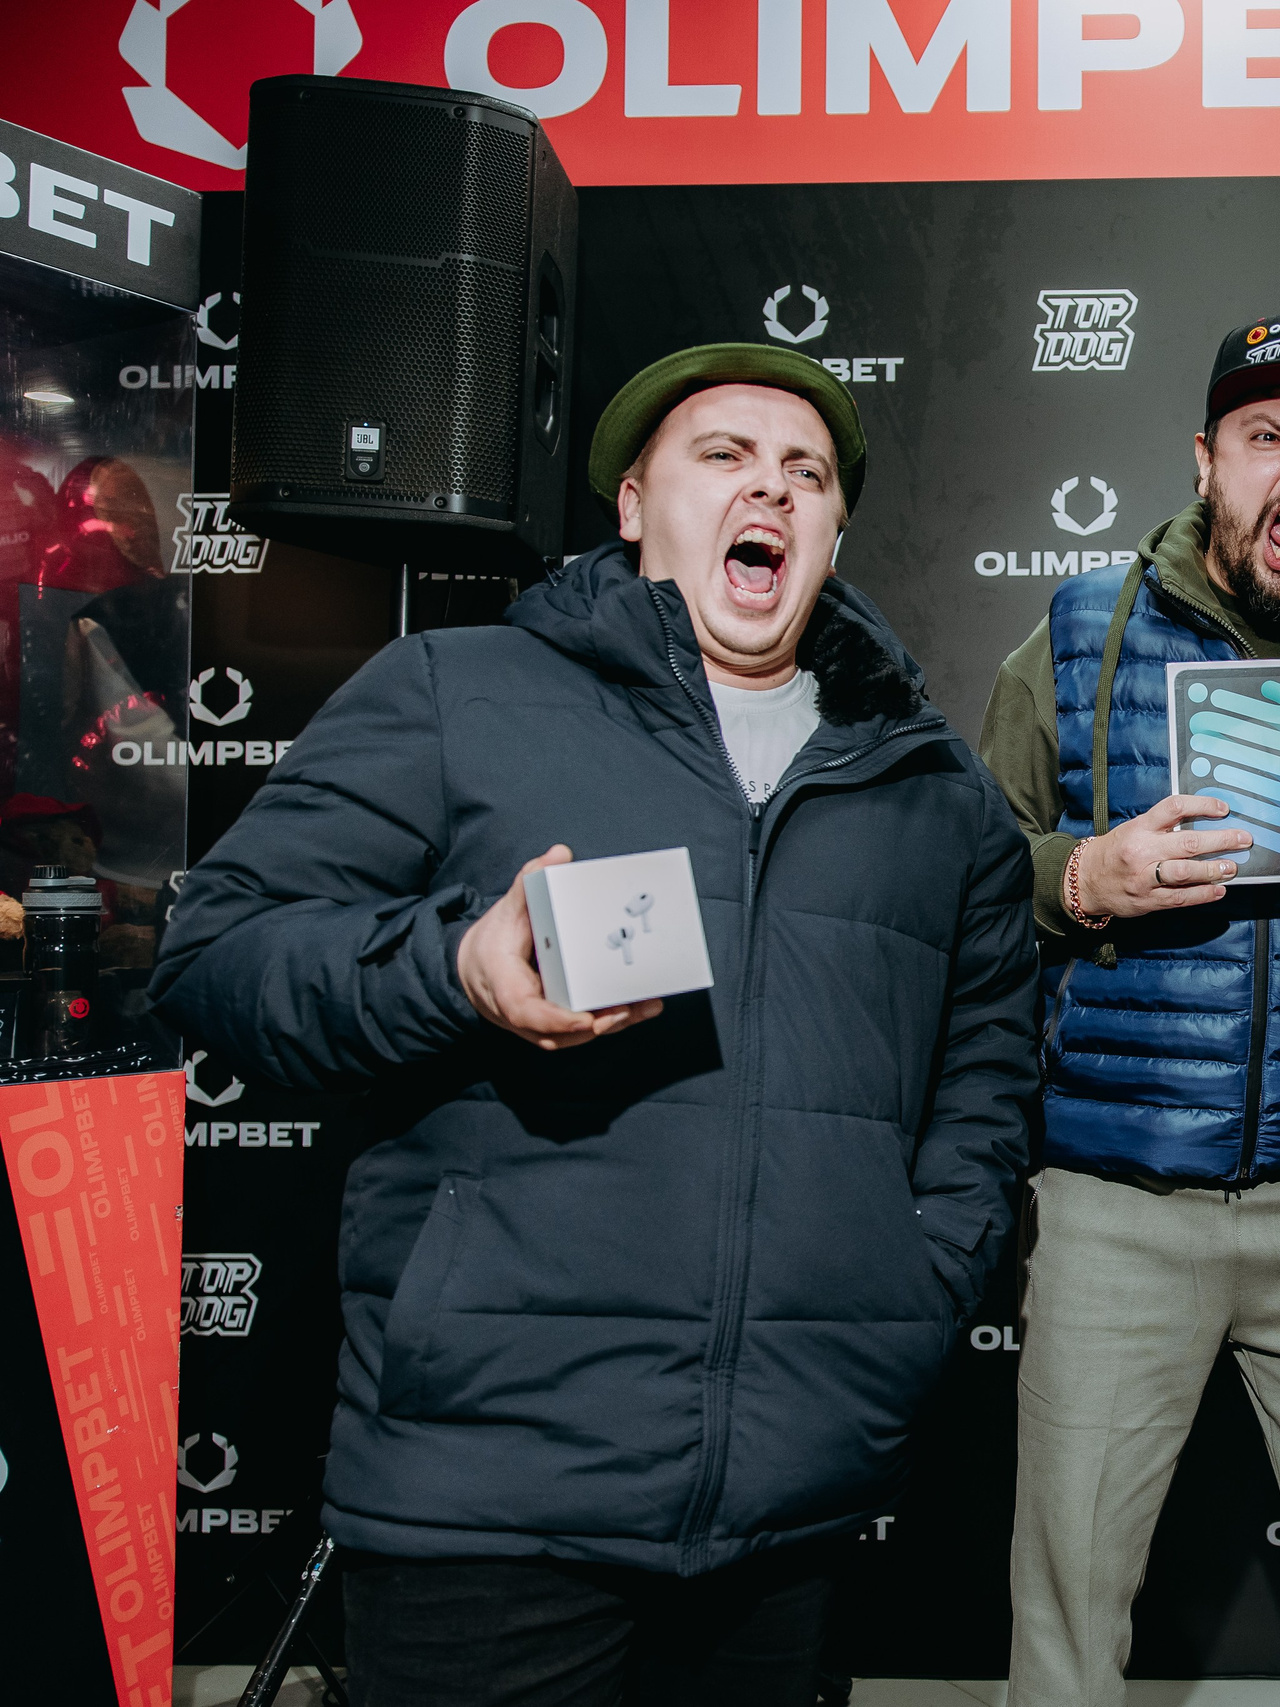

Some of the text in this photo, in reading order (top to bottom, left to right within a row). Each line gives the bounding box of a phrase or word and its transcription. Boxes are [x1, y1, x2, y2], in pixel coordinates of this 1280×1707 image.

[1042, 331, 1126, 363] DOG
[1046, 297, 1129, 329] TOP
[356, 433, 374, 445] JBL
[116, 1165, 140, 1243] OLIMPBET
[88, 1250, 109, 1315] OLIMPBET
[123, 1267, 148, 1343] OLIMPBET
[56, 1346, 145, 1624] OLIMPBET
[136, 1502, 174, 1621] OLIMPBET
